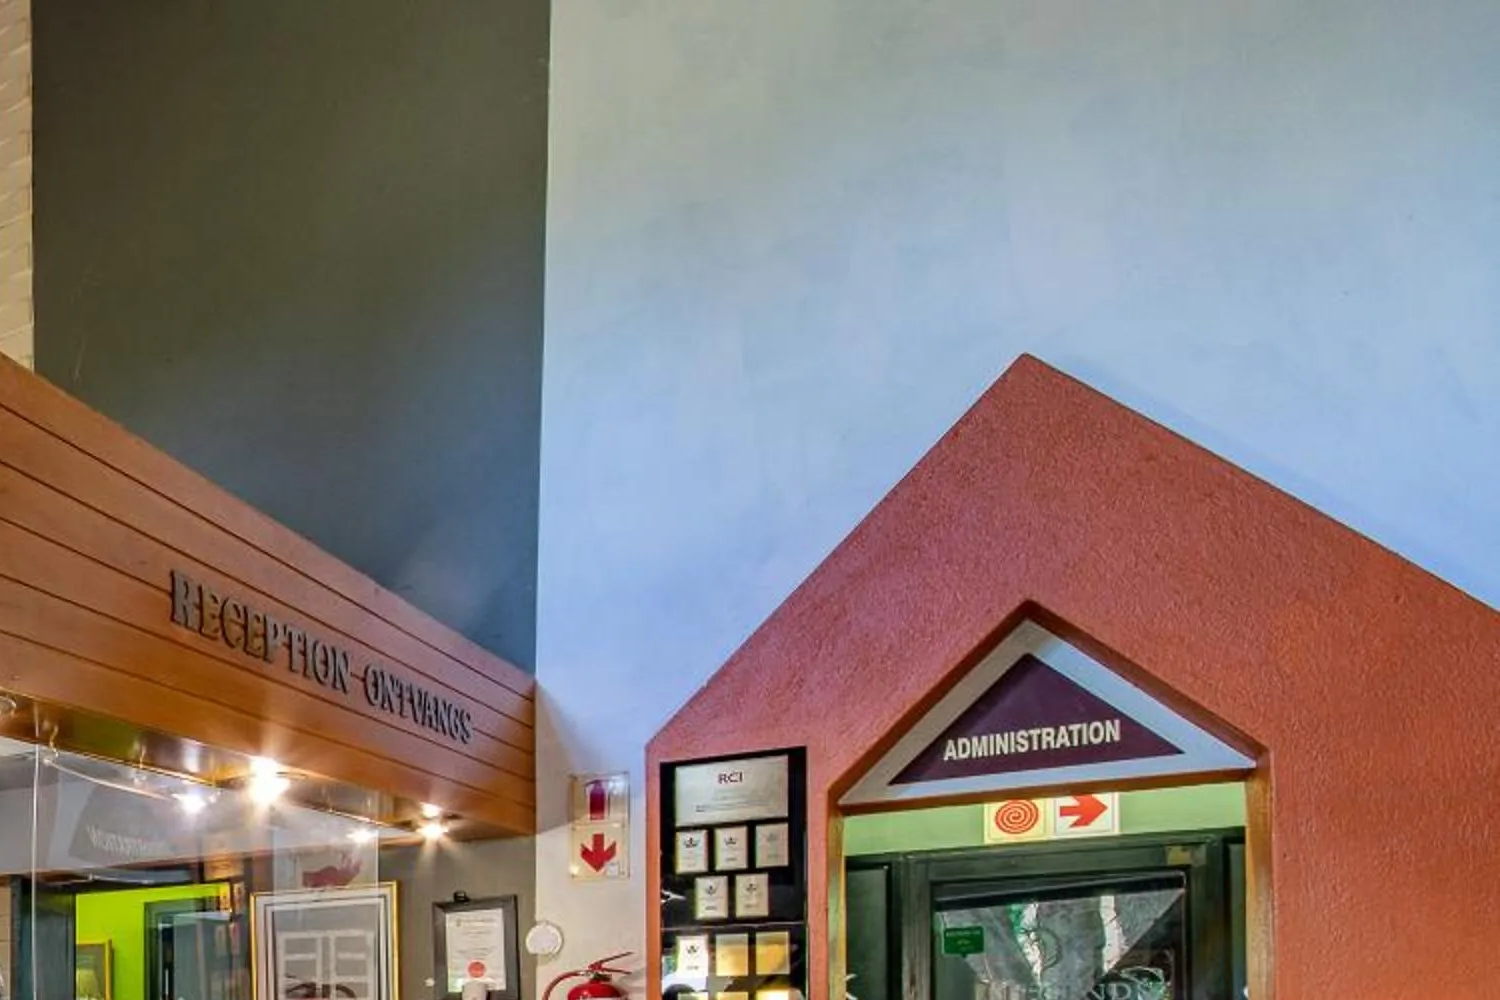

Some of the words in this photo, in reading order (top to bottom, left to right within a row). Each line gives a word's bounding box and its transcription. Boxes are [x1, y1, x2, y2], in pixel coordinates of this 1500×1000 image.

[171, 569, 350, 697] RECEPTION
[363, 662, 474, 745] ONTVANGS
[942, 719, 1122, 762] ADMINISTRATION
[718, 771, 743, 785] RCI
